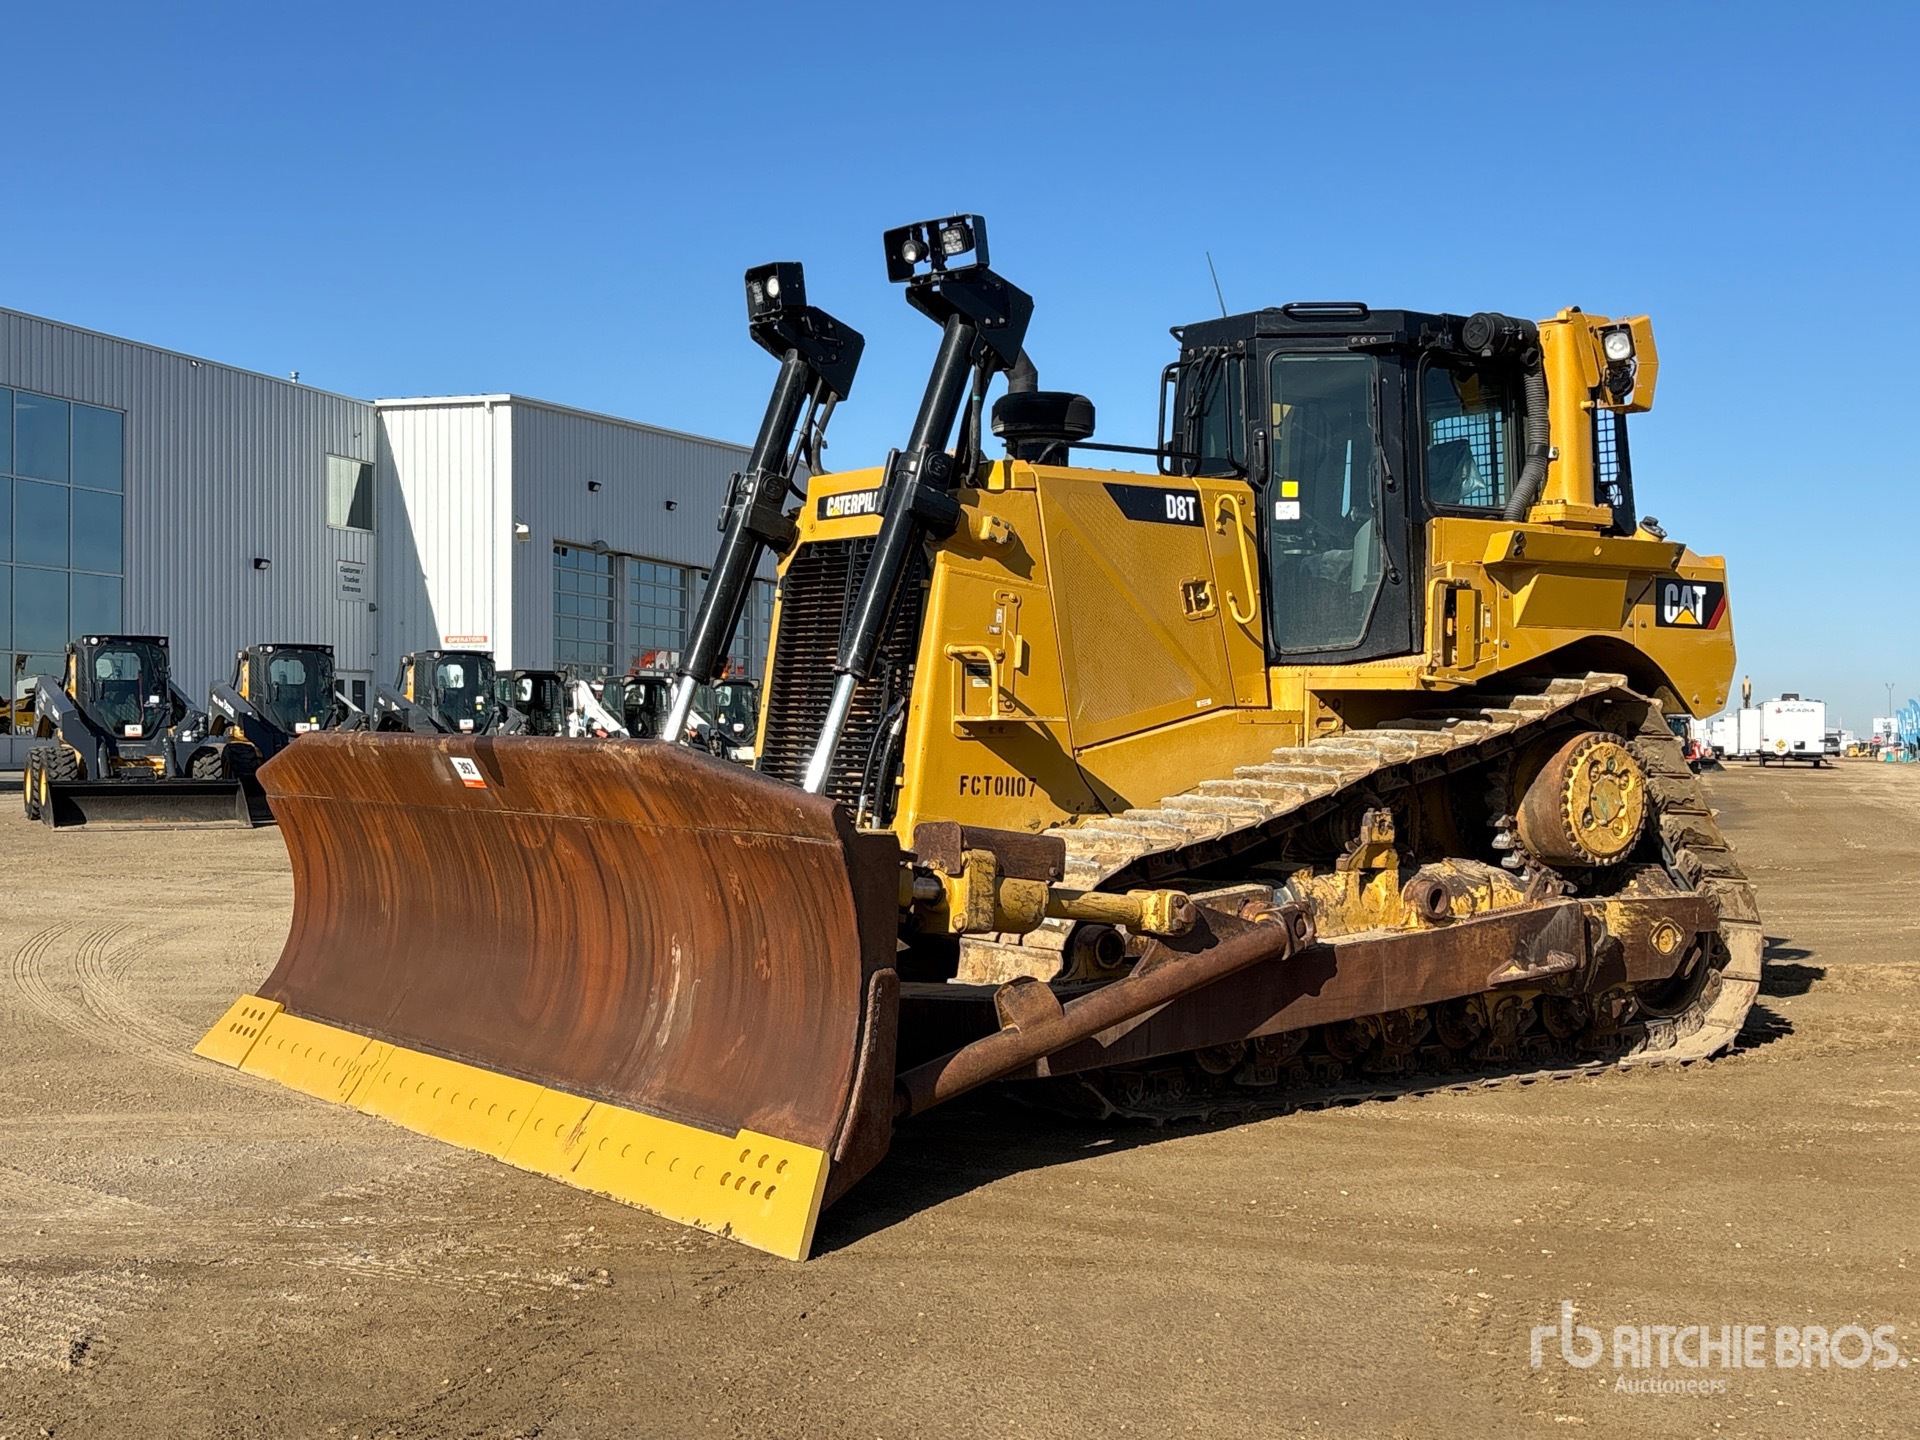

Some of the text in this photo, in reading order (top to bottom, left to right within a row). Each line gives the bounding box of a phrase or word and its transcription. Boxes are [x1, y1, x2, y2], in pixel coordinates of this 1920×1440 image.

[1165, 494, 1196, 521] D8T
[340, 565, 360, 575] Customer
[343, 575, 360, 584] Trucker
[342, 584, 362, 593] Entrance
[1664, 583, 1707, 626] CAT
[959, 775, 1037, 798] FCT01107
